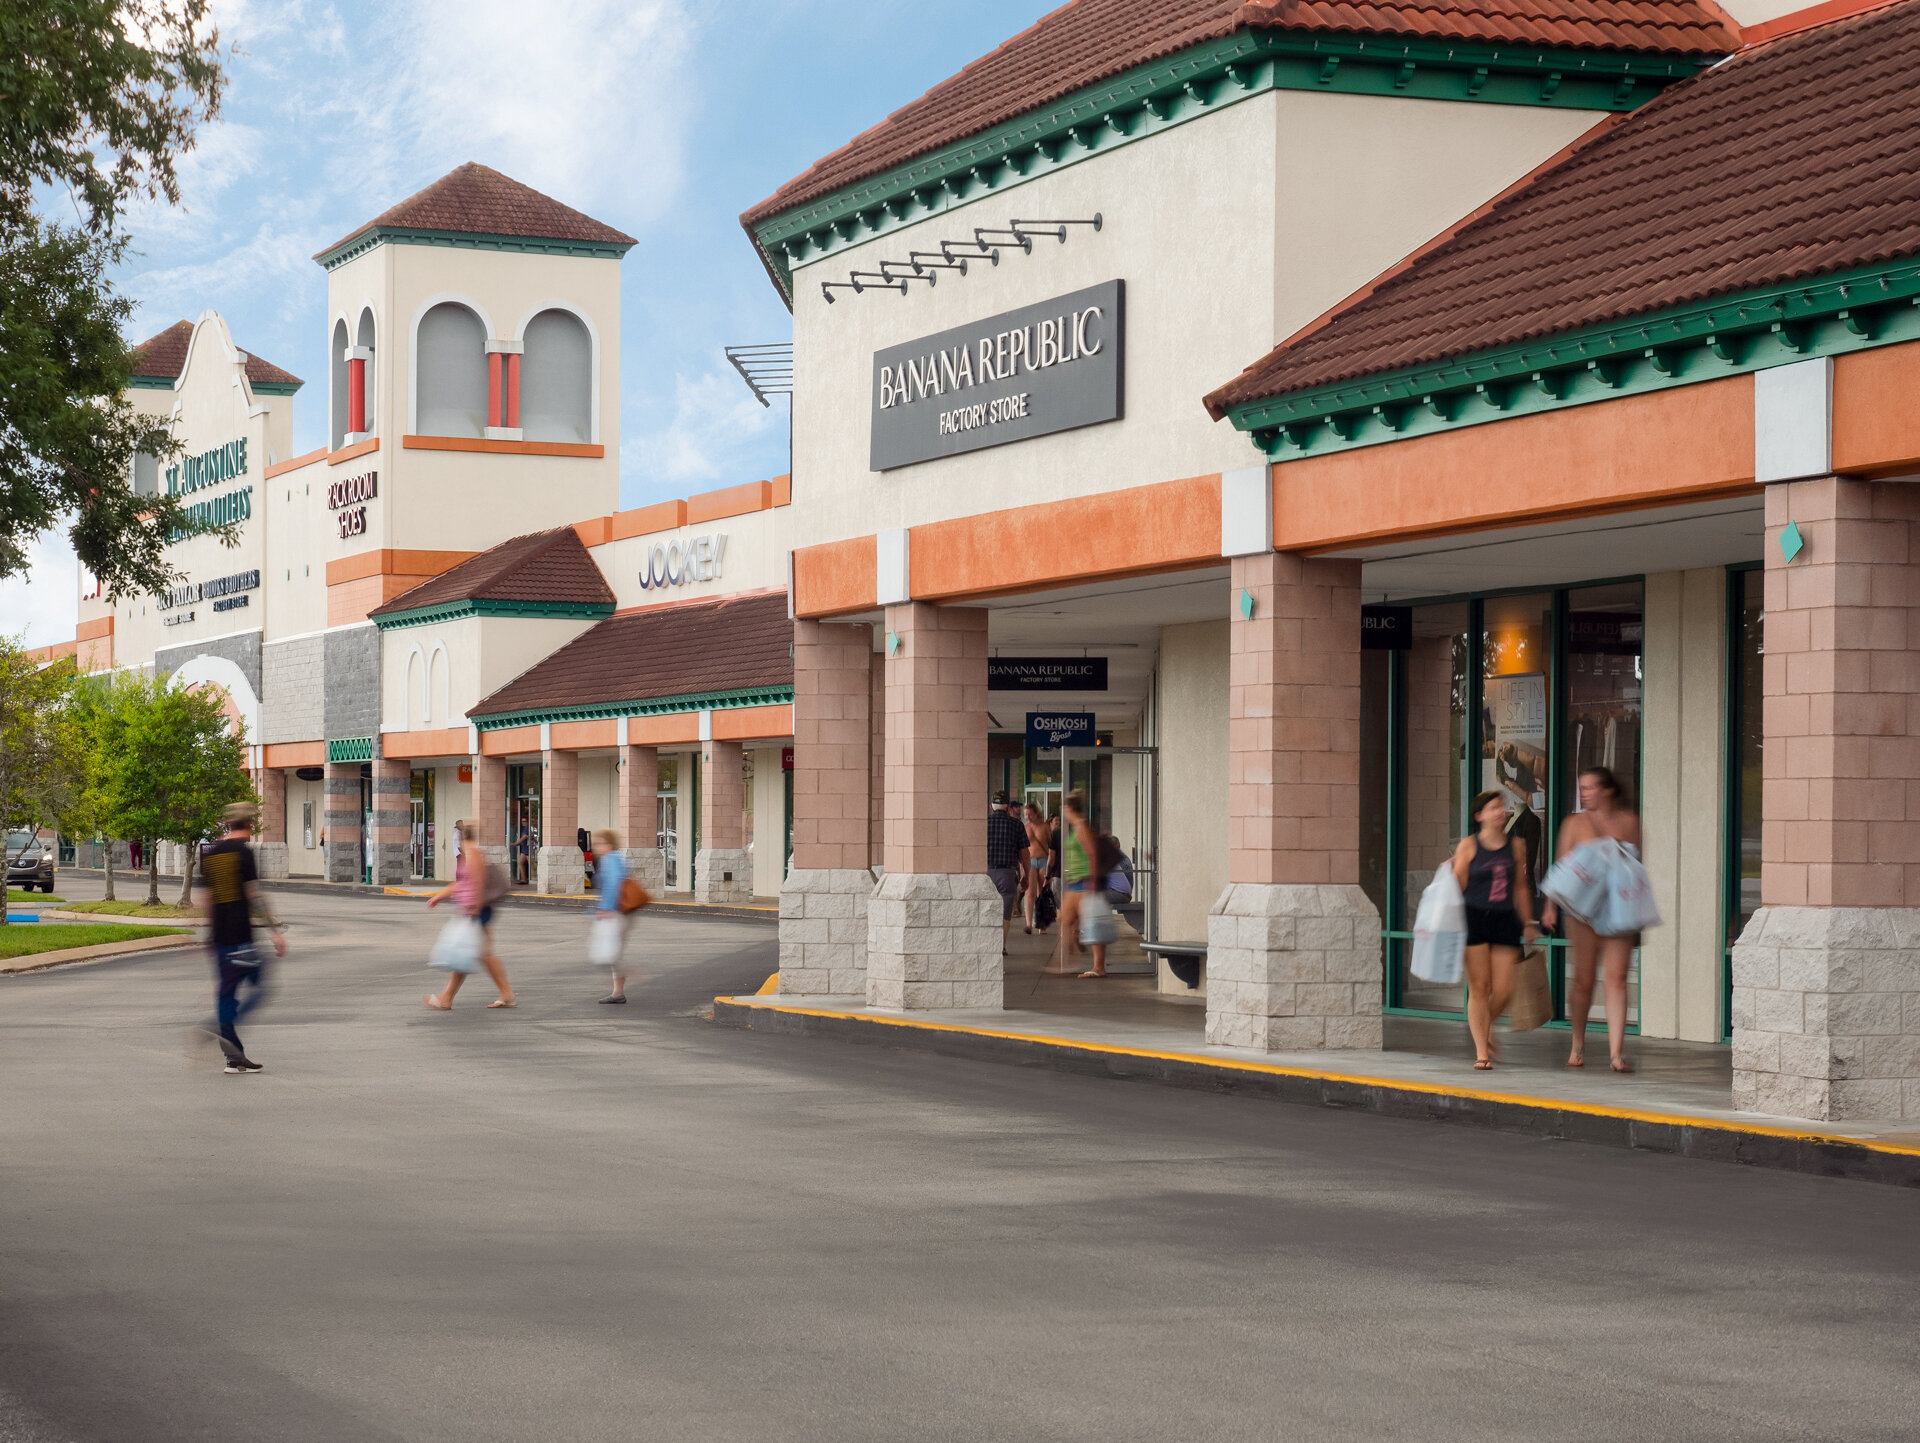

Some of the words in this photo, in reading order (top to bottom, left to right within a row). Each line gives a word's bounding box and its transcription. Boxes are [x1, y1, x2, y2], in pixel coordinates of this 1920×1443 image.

[880, 344, 974, 409] BANANA
[979, 306, 1104, 383] REPUBLIC
[939, 402, 987, 435] FACTORY
[990, 392, 1031, 424] STORE
[180, 437, 248, 496] AUGUSTINE
[205, 485, 252, 529] OUTLETS
[337, 506, 367, 539] SHOES
[638, 531, 728, 590] JOCKEY
[225, 569, 260, 594] BROTHERS
[989, 665, 1037, 675] BANANA
[1039, 665, 1093, 675] REPUBLIC
[1500, 682, 1525, 700] LIFE
[1530, 681, 1543, 698] IN
[1506, 702, 1543, 720] STYLE
